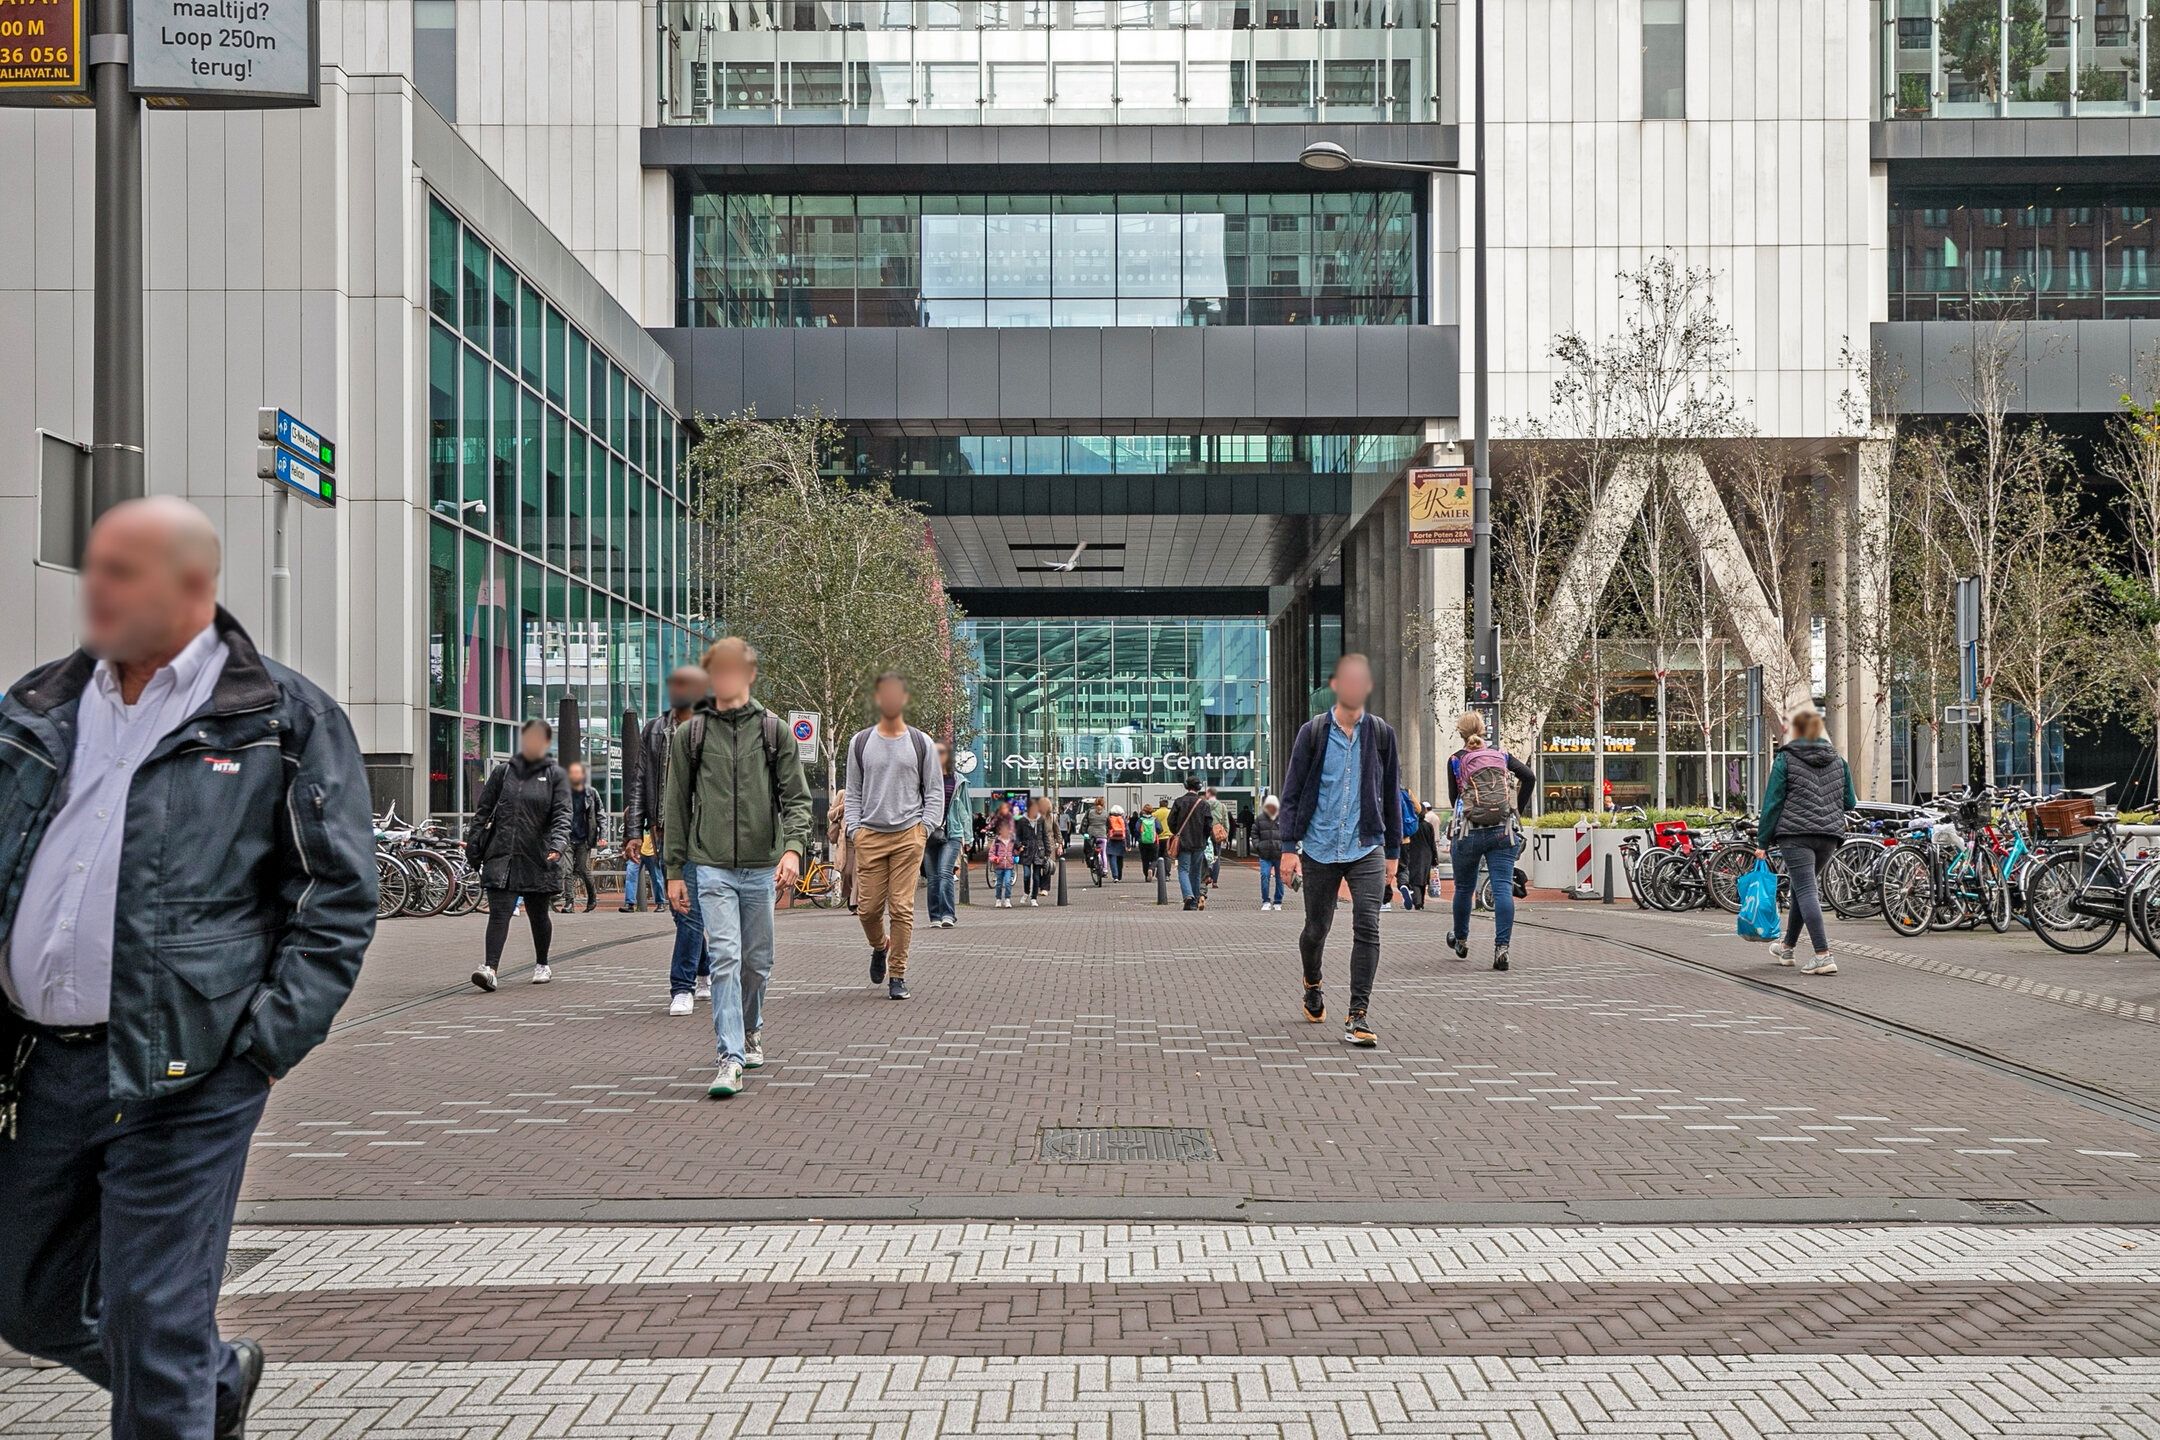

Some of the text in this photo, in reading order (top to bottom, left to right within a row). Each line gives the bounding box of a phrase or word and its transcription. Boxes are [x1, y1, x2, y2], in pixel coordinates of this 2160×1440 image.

[173, 0, 270, 23] maaltijd?
[28, 20, 45, 36] M
[162, 27, 276, 50] Loop 250m
[30, 47, 68, 63] 056
[0, 67, 70, 79] ALHAYAT.NL
[191, 58, 252, 81] terug!
[1432, 509, 1470, 519] AMIER
[1602, 735, 1636, 746] Tacos
[212, 762, 241, 771] HTM
[1097, 752, 1155, 775] Haag
[1162, 750, 1255, 770] Centraal
